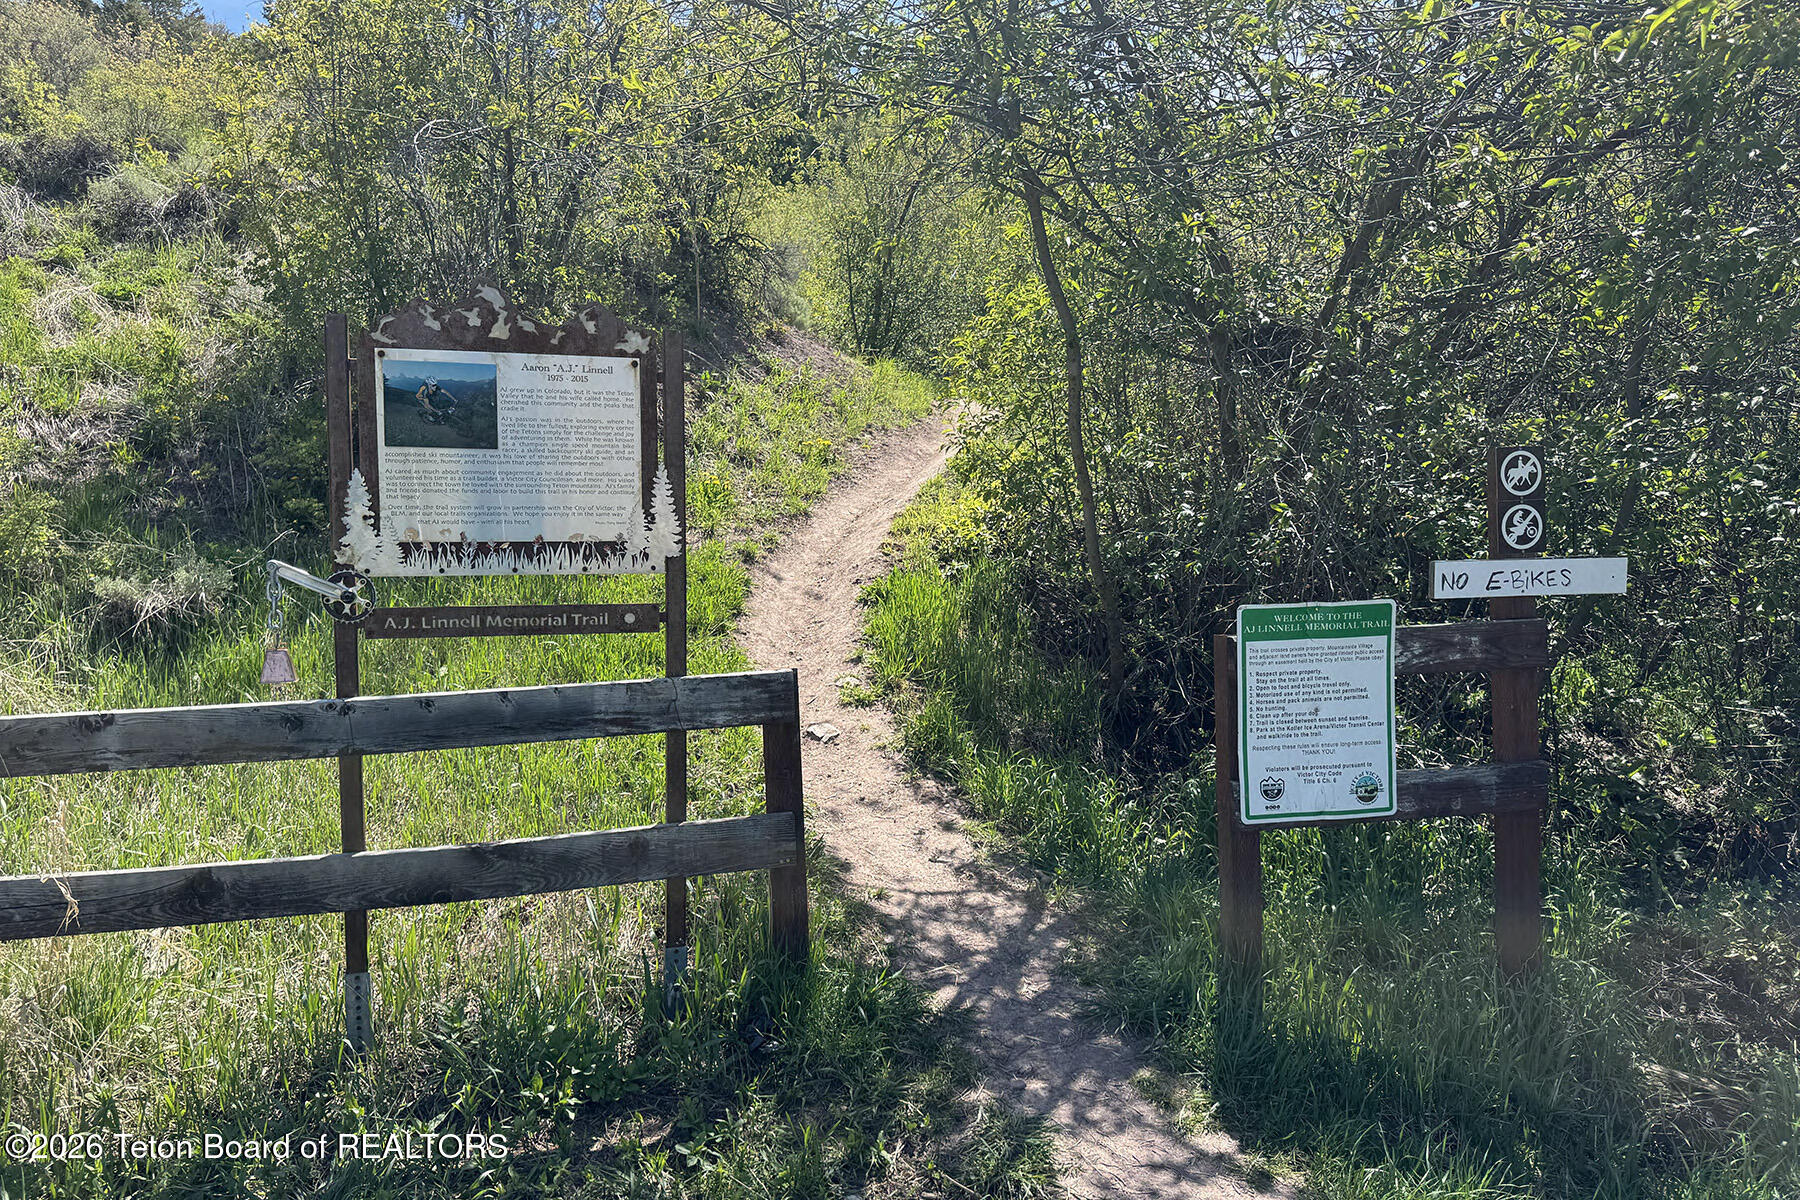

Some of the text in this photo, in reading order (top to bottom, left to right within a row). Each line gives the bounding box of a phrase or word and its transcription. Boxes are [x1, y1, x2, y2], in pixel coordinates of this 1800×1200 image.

[521, 363, 550, 372] Aaron
[582, 365, 613, 374] Linnell
[1442, 572, 1469, 591] NO
[384, 613, 608, 629] A.J. Linnell Memorial Trail
[1274, 613, 1324, 623] WELCOME
[1343, 611, 1362, 620] THE
[1258, 623, 1302, 633] LINNELL
[1305, 620, 1358, 630] MEMORIAL
[1361, 619, 1390, 628] TRAIL
